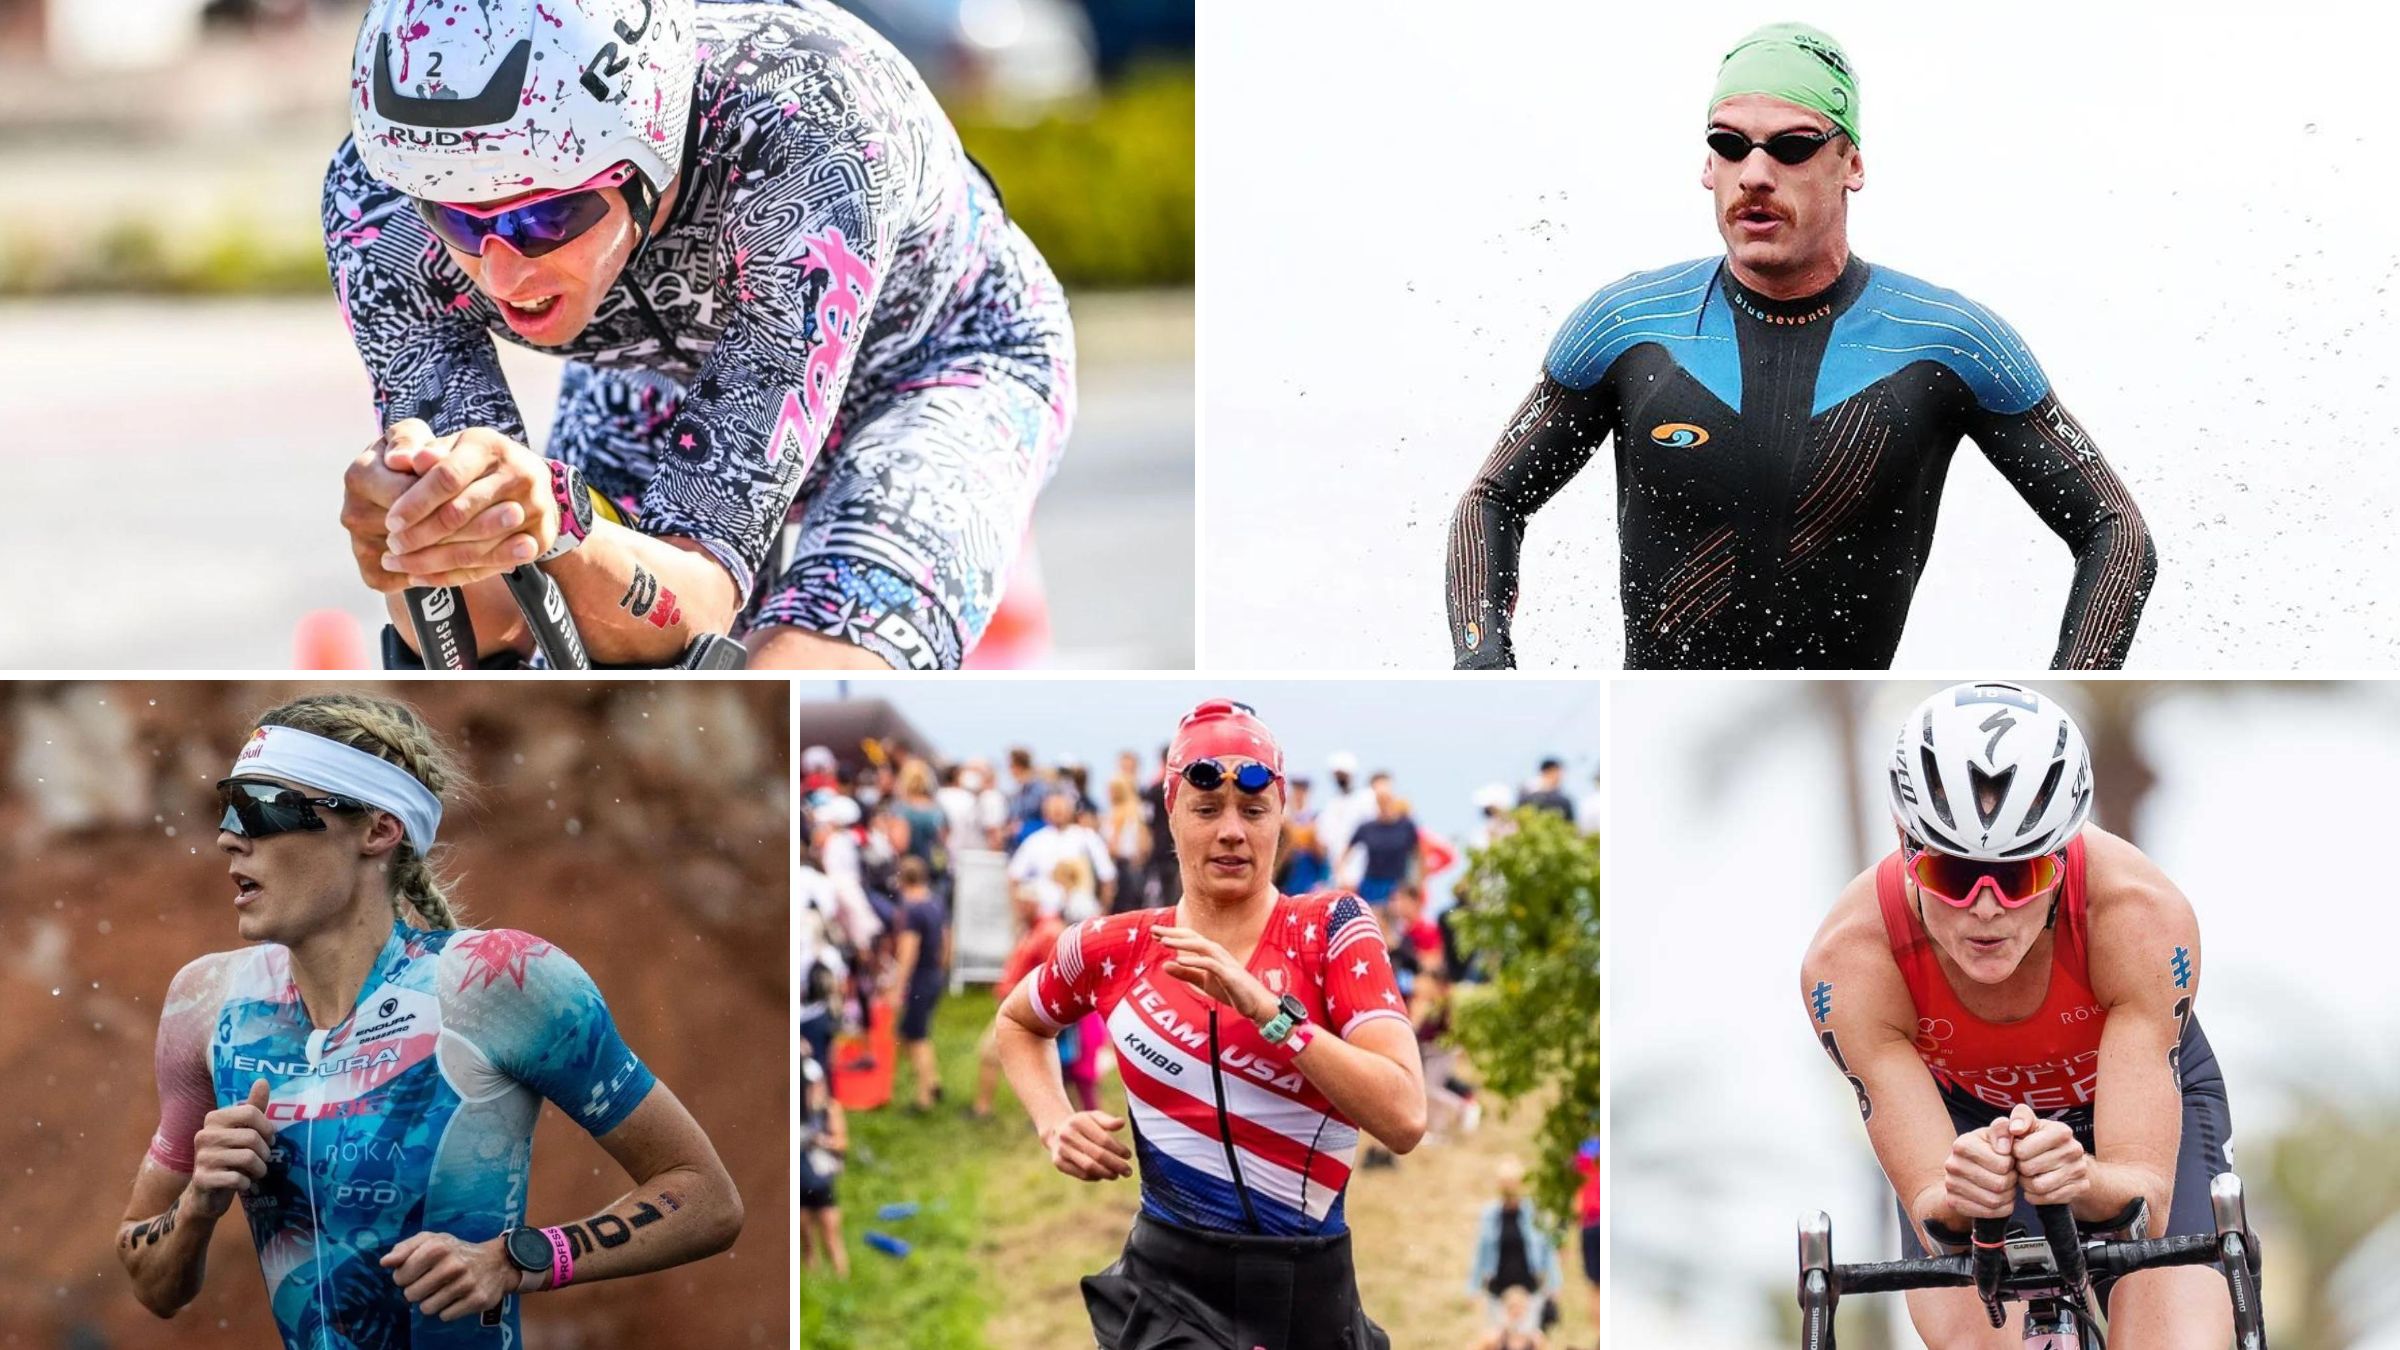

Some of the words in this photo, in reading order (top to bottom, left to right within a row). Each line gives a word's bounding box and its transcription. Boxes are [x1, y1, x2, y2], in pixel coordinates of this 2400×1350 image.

[426, 52, 442, 77] 2
[389, 126, 488, 153] RUDY
[1734, 293, 1832, 325] blueseventy
[1508, 388, 1551, 443] helix
[2046, 404, 2099, 463] helix
[355, 1013, 416, 1037] ENDURA
[1131, 978, 1210, 1049] TEAM
[1220, 1044, 1305, 1093] USA
[233, 1048, 400, 1078] ENDURA
[1124, 1033, 1184, 1076] KNIBB
[336, 1185, 398, 1204] PTO
[2013, 1242, 2045, 1250] GARMIN
[2231, 1268, 2246, 1313] SHIMANO
